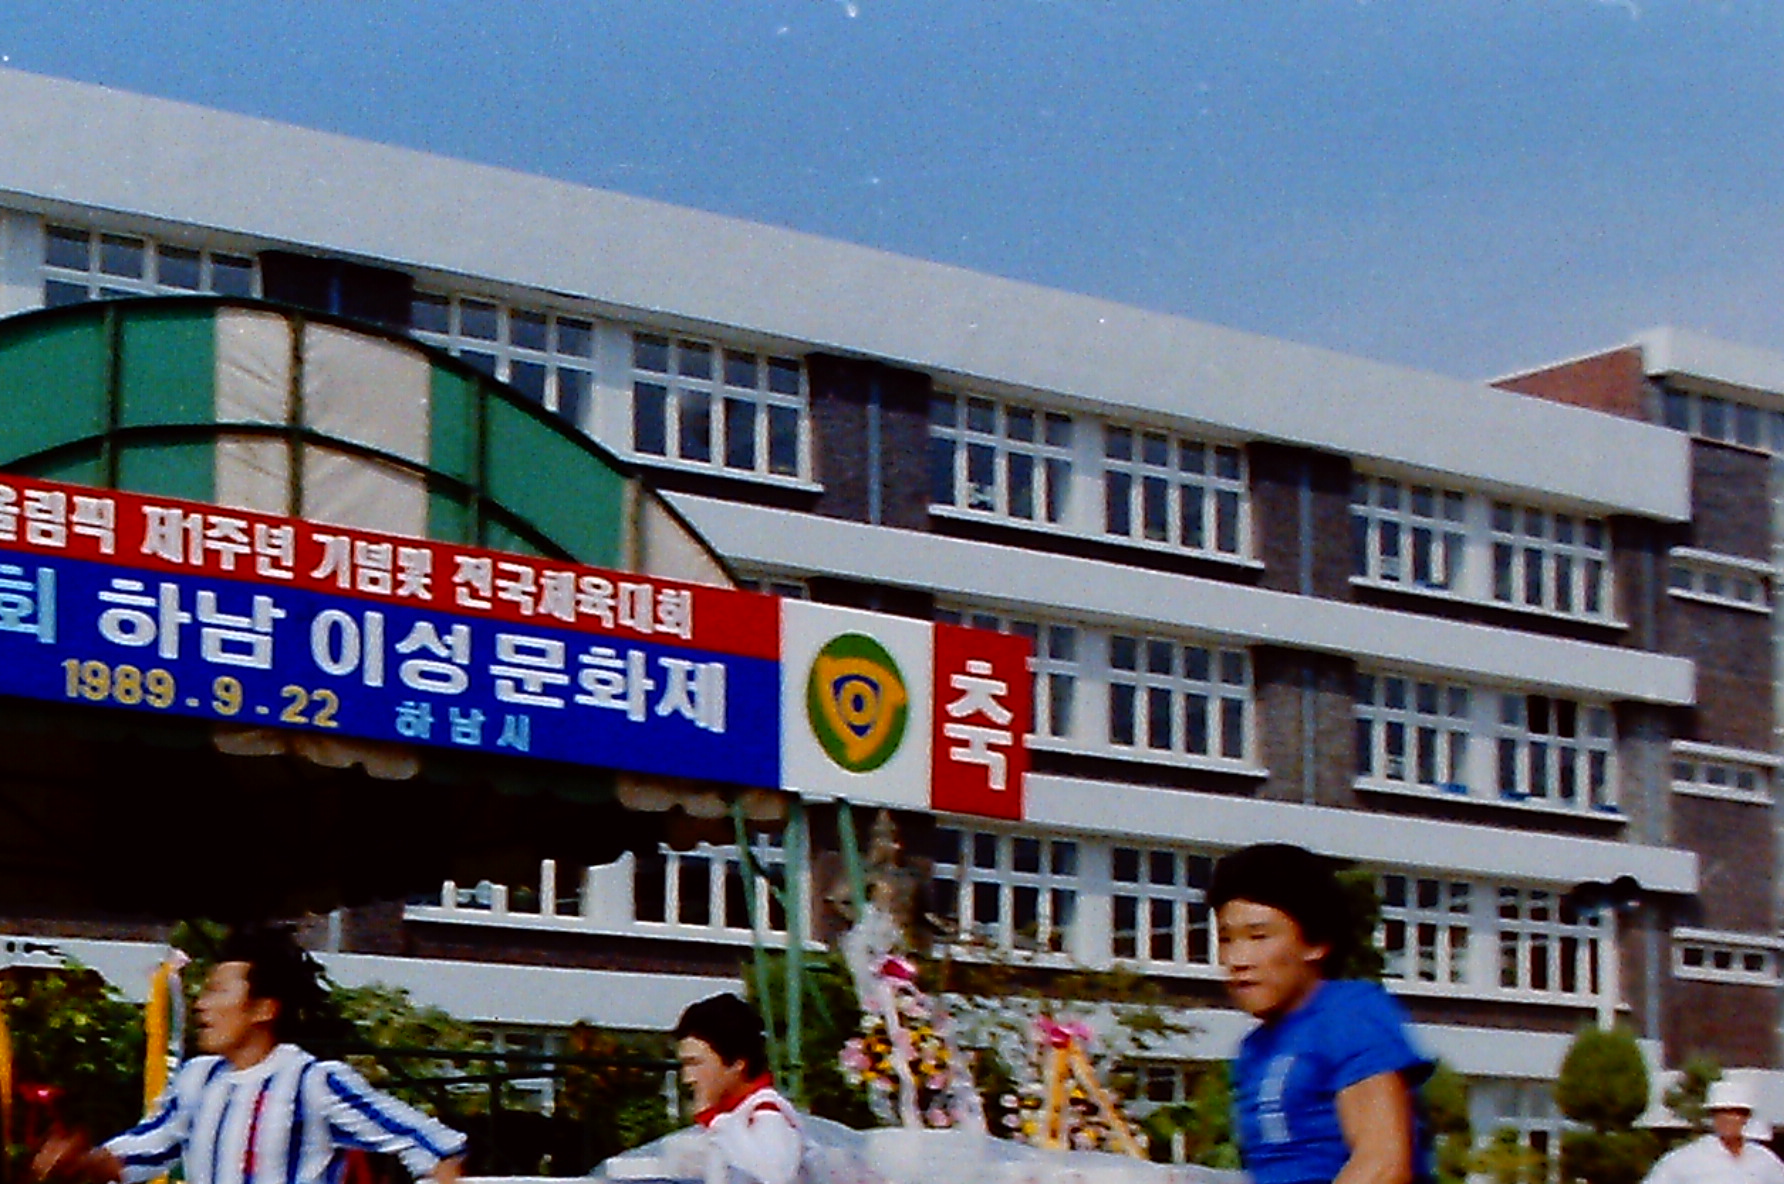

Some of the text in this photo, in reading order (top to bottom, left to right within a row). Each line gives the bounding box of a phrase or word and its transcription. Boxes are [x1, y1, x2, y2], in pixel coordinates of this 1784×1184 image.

[97, 578, 286, 669] 하남
[141, 506, 295, 579] 제1주년
[452, 555, 693, 640] 전국체육대회
[943, 660, 1014, 791] 축
